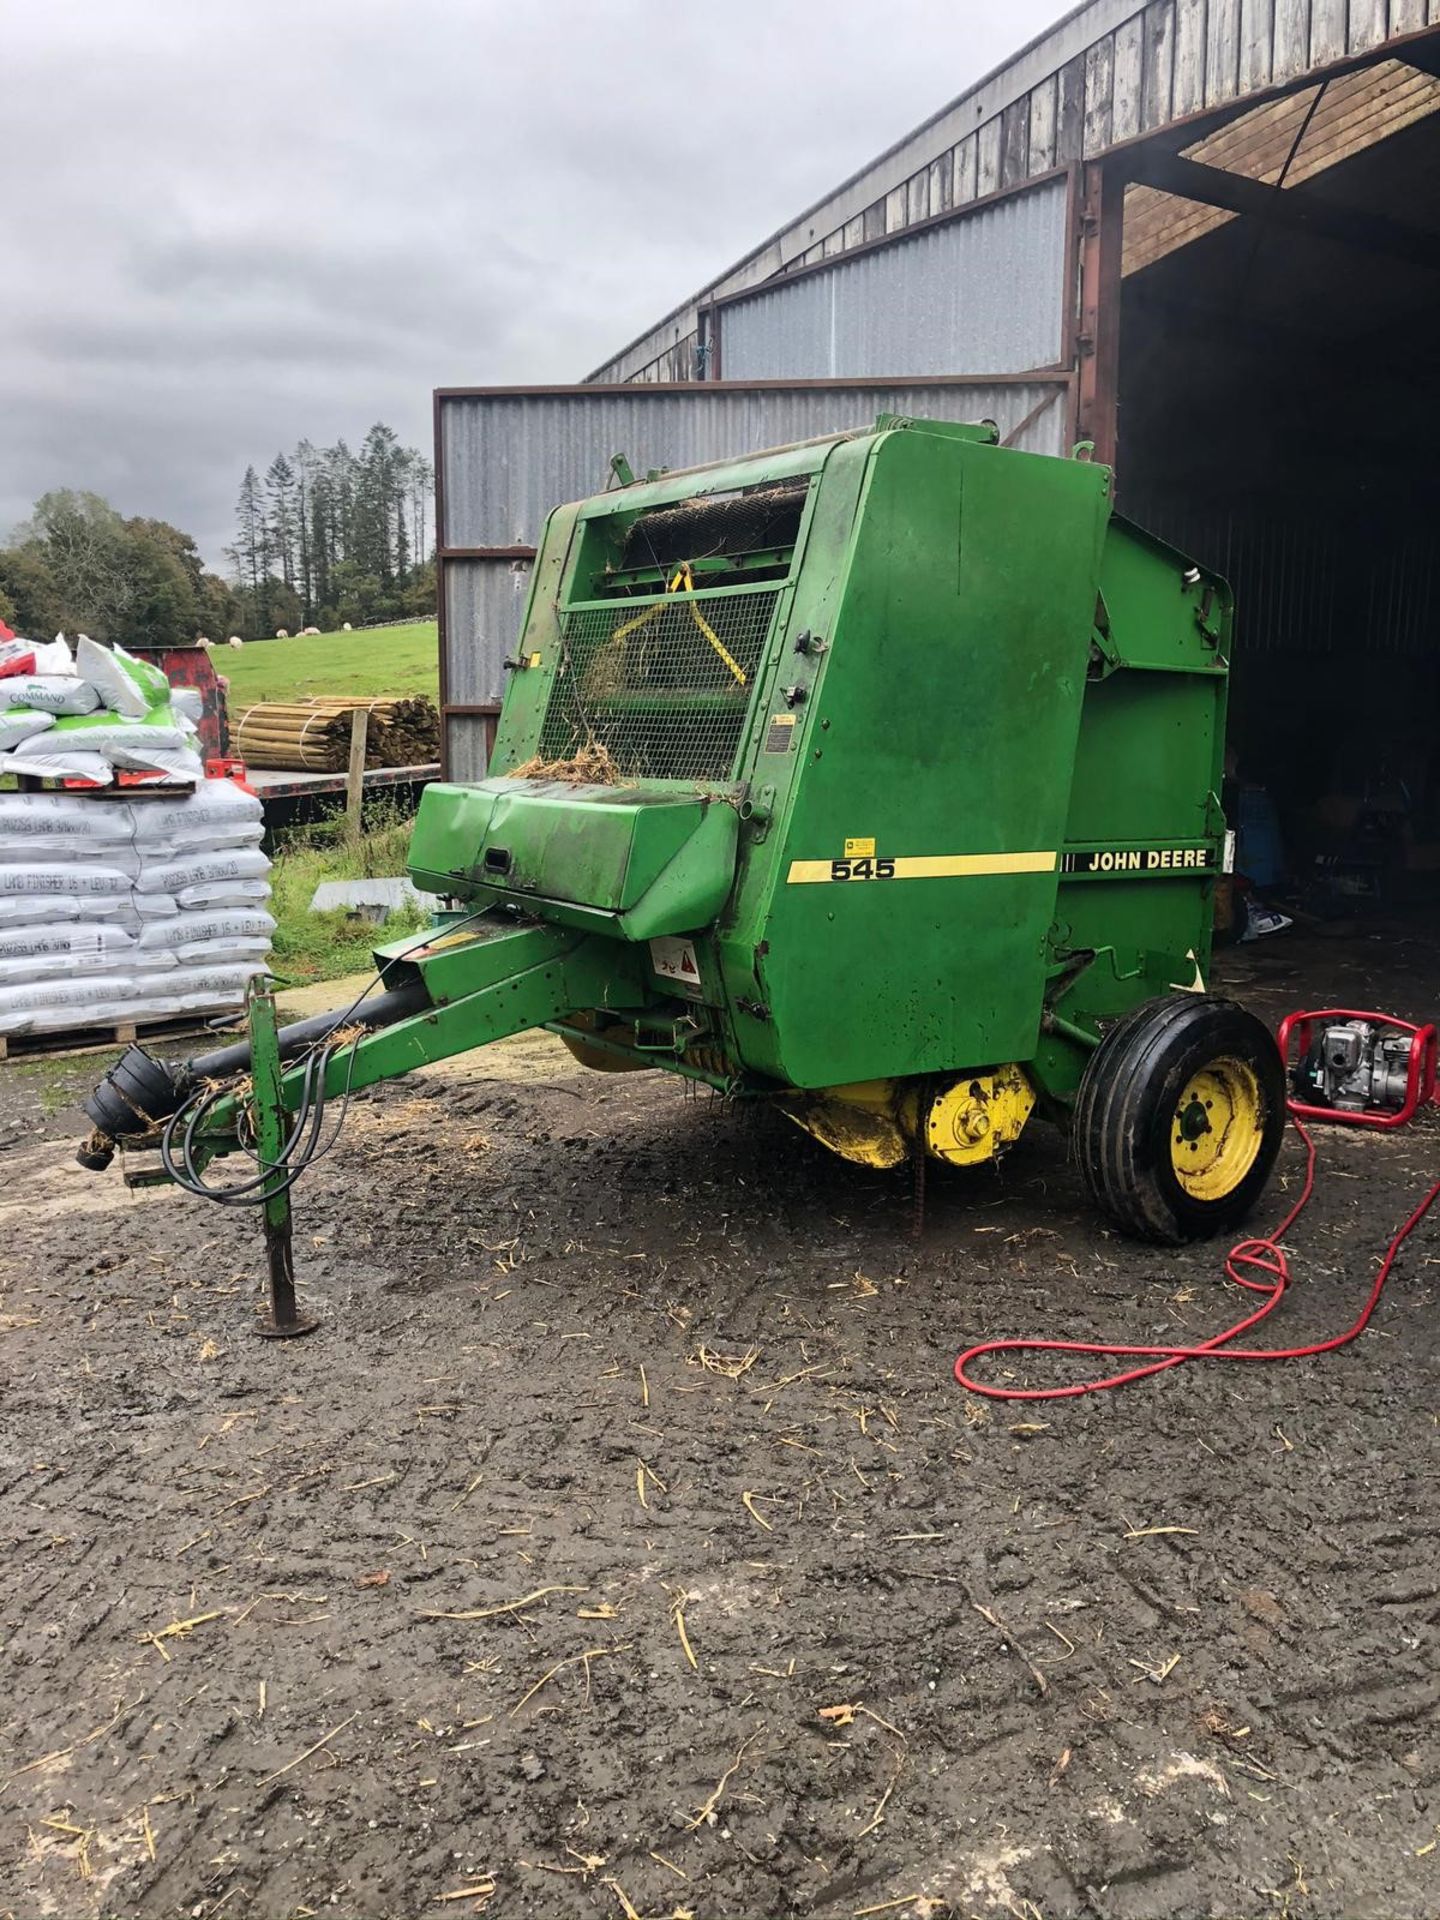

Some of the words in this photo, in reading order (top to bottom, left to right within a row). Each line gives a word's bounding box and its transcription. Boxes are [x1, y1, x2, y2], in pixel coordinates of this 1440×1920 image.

[9, 690, 66, 705] COMMAND
[831, 858, 895, 881] 545
[1088, 851, 1141, 871] JOHN
[1147, 849, 1207, 869] DEERE
